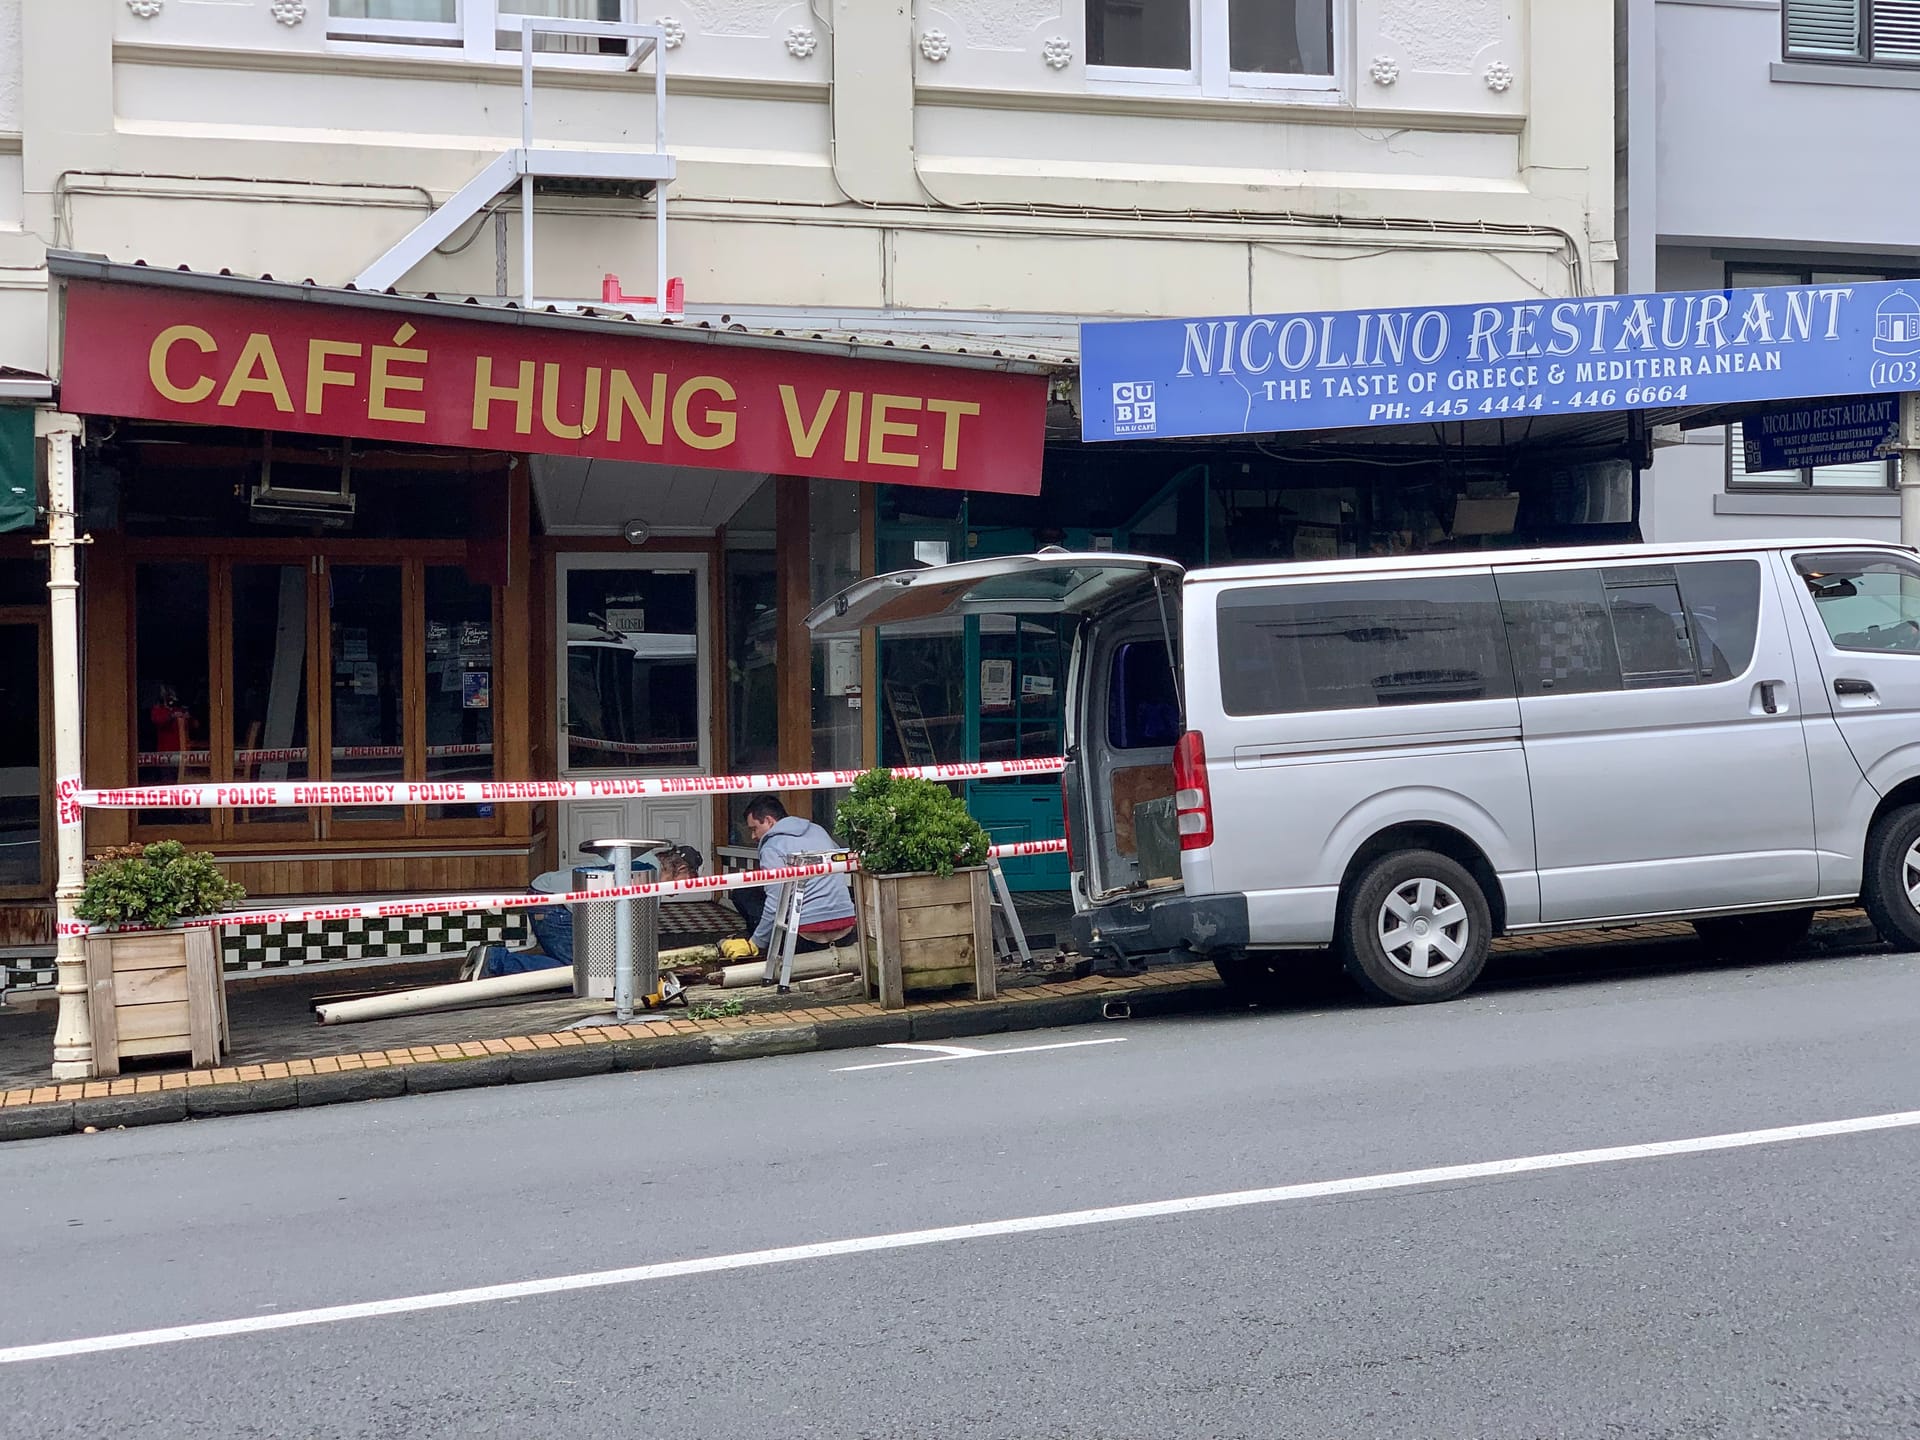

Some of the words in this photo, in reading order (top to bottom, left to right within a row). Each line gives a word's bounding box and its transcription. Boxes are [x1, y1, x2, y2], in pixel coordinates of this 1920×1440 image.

[1176, 310, 1450, 377] NICOLINO
[1464, 288, 1854, 364] RESTAURANT
[1262, 379, 1312, 401] THE
[1321, 374, 1400, 398] TASTE
[1407, 372, 1437, 393] OF
[1447, 365, 1539, 391] GREECE
[1547, 363, 1566, 385] &
[1575, 350, 1782, 383] MEDITERRANEAN
[150, 323, 428, 423] CAFÉ
[473, 356, 737, 450] HUNG
[780, 384, 980, 471] VIET
[1369, 403, 1411, 421] PH:
[1419, 399, 1469, 417] 445
[1478, 395, 1544, 414] 4444
[1567, 390, 1617, 408] 446
[1624, 384, 1688, 404] 6664
[1116, 425, 1131, 433] BAR
[1762, 411, 1811, 434] NICOLINO
[1813, 401, 1892, 428] RESTAURANT
[1784, 434, 1800, 446] TASTE
[1809, 431, 1829, 442] GREECE
[1835, 426, 1883, 440] MEDITERRANEAN
[1801, 455, 1813, 465] 445
[1837, 451, 1850, 462] 446
[239, 749, 305, 763] EMERGENCY
[97, 787, 203, 806] EMERGENCY
[217, 786, 277, 805] POLICE
[294, 784, 395, 804] EMERGENCY
[408, 783, 466, 801] POLICE
[481, 780, 578, 799] EMERGENCY
[591, 779, 646, 795] POLICE
[661, 774, 753, 793] EMERGENCY
[767, 771, 820, 787] POLICE
[936, 760, 989, 776] POLICE
